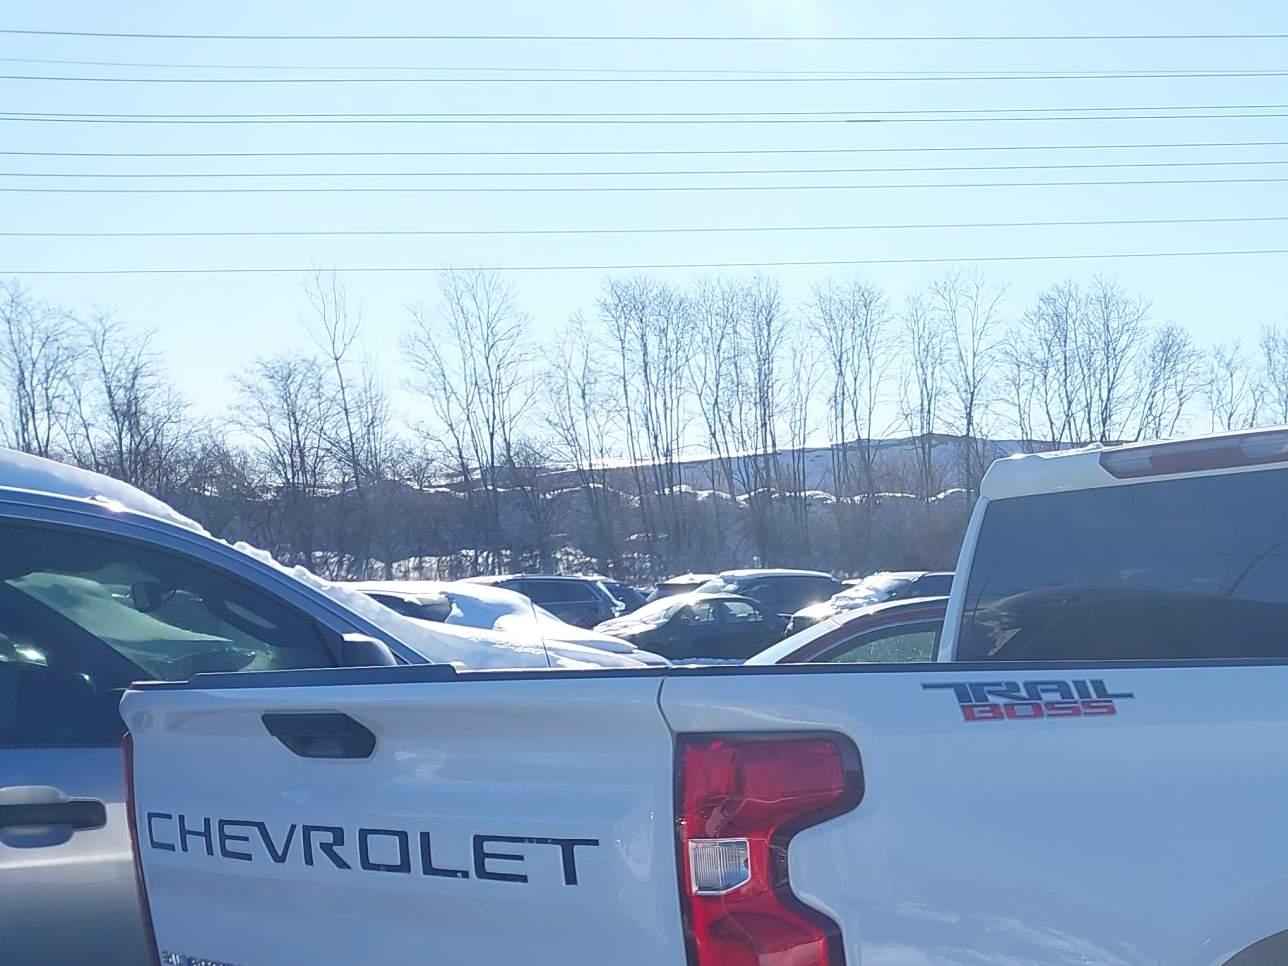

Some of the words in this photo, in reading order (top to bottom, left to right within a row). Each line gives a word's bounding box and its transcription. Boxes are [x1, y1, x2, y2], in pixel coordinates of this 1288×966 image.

[921, 679, 1135, 703] TRAIL
[961, 700, 1117, 722] BOSS
[147, 812, 600, 886] CHEVROLET
